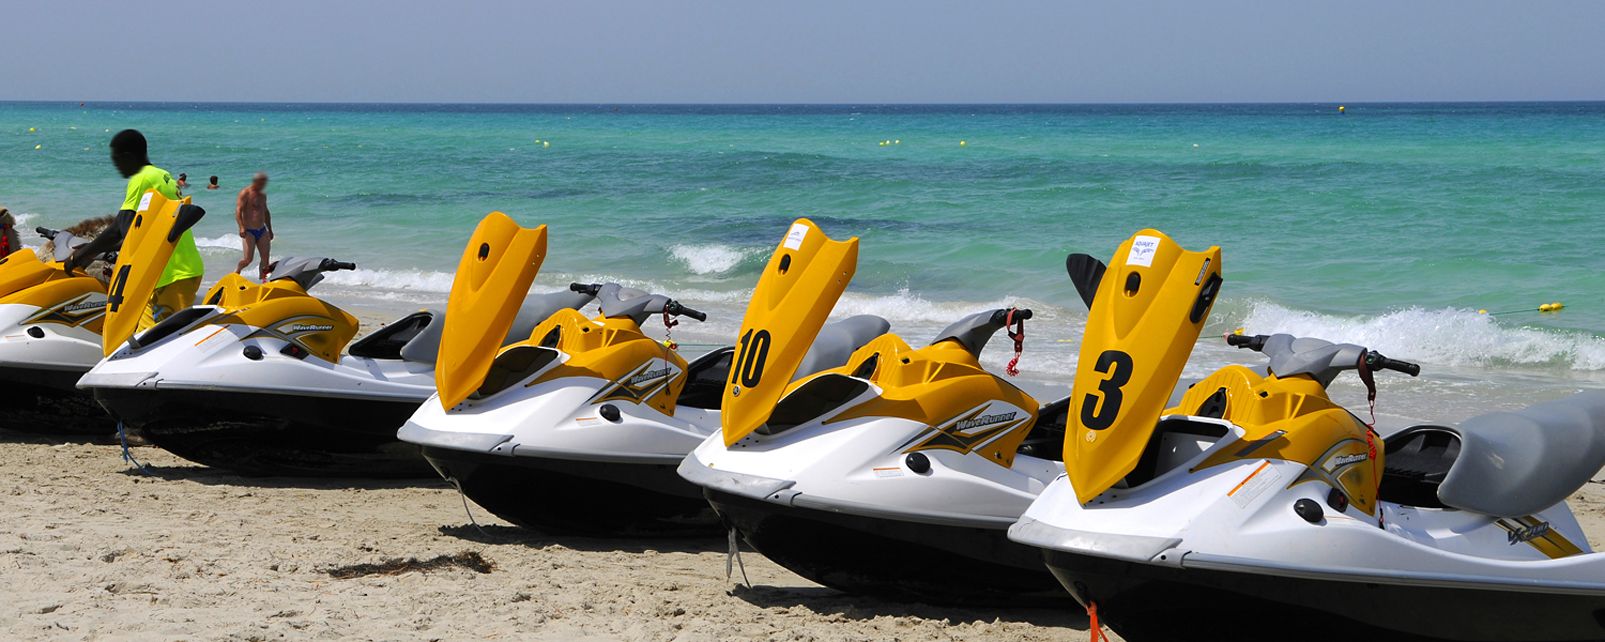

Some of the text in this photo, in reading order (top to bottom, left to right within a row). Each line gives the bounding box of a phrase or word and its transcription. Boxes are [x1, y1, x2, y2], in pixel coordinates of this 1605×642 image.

[110, 264, 131, 312] 4
[64, 301, 107, 312] WaveRunne
[292, 323, 334, 332] WaveRunner
[731, 328, 771, 388] 10
[1080, 350, 1134, 431] 3
[956, 411, 1017, 431] WaveRunner
[1335, 452, 1368, 466] WaveRunner
